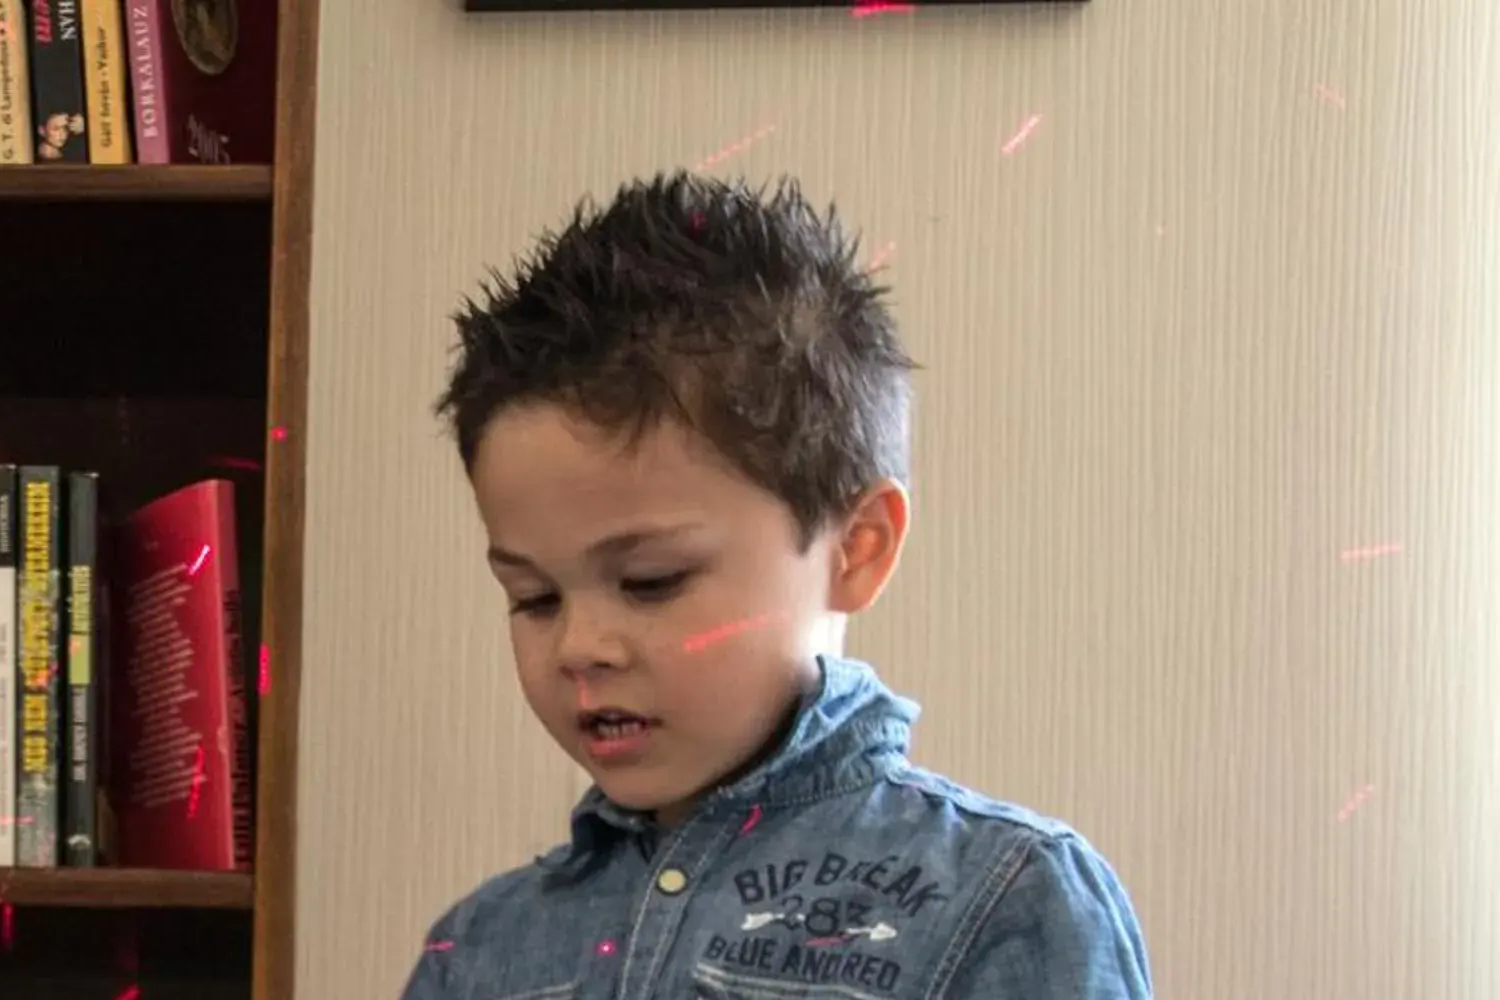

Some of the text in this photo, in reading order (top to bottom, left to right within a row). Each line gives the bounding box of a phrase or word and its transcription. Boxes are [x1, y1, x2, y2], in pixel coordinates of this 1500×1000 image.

[132, 4, 159, 139] BORKALAUZ
[813, 852, 948, 919] BREAK
[704, 935, 777, 969] BLUE
